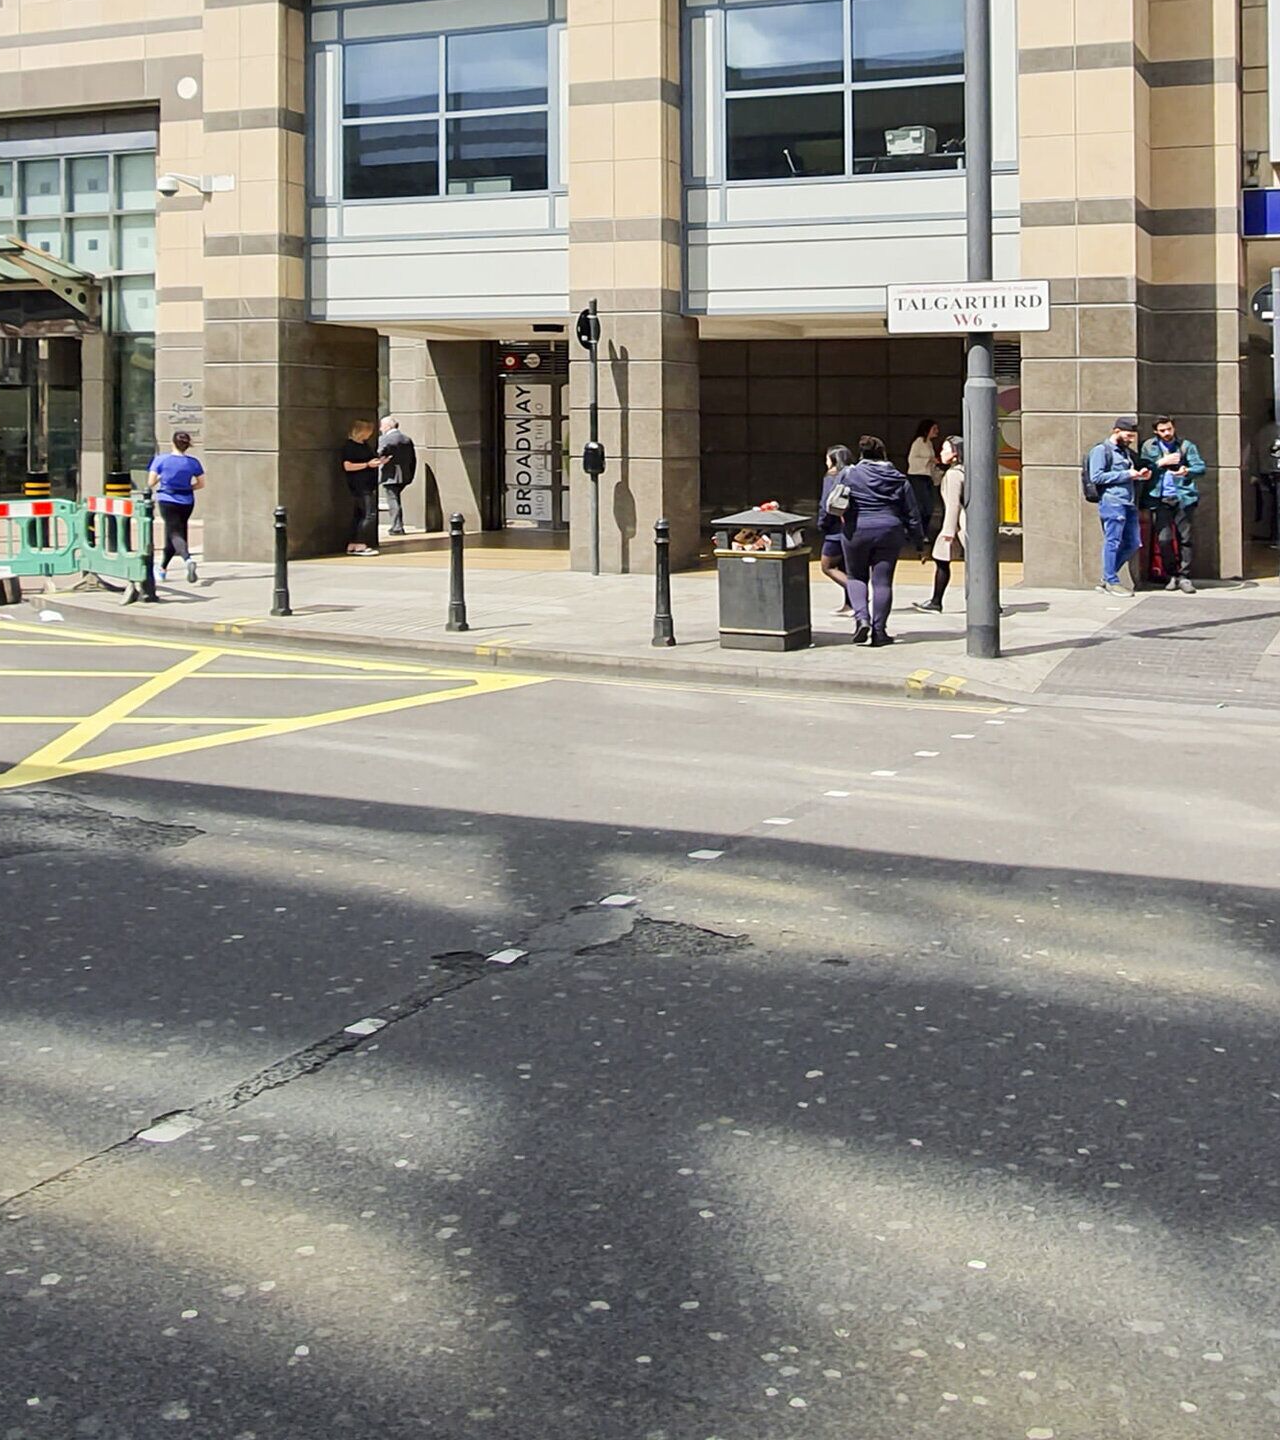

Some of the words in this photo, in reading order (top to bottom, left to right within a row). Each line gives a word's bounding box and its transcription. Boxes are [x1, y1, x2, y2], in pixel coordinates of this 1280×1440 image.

[894, 295, 1006, 311] TALGARTH
[1014, 295, 1043, 308] RD
[953, 313, 983, 327] W6
[515, 385, 532, 516] BROADWAY
